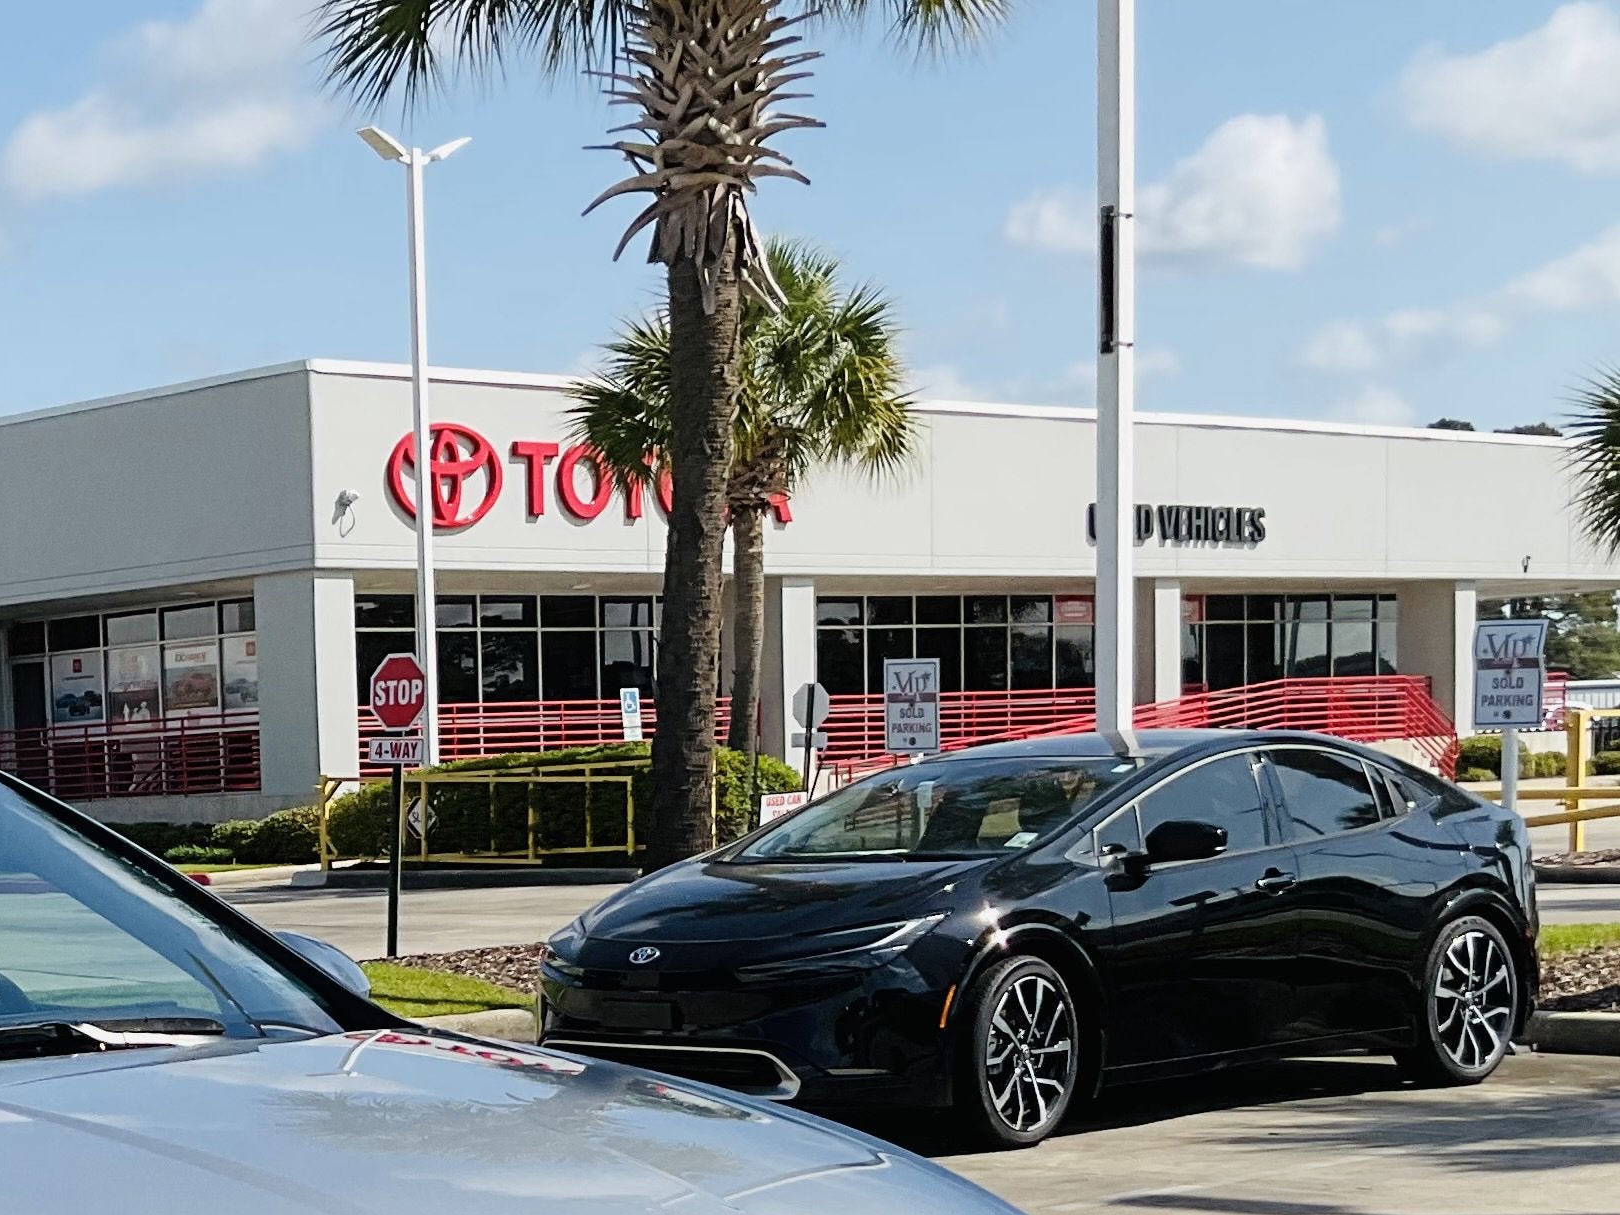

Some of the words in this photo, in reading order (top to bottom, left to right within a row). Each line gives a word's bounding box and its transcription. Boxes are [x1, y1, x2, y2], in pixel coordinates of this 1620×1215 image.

[1156, 504, 1266, 544] VEHICLES
[1492, 676, 1524, 689] SOLD
[374, 679, 423, 707] STOP
[1481, 694, 1533, 707] PARKING
[899, 707, 924, 719] SOLD
[891, 722, 932, 734] PARKING
[374, 741, 418, 759] 4-WAY
